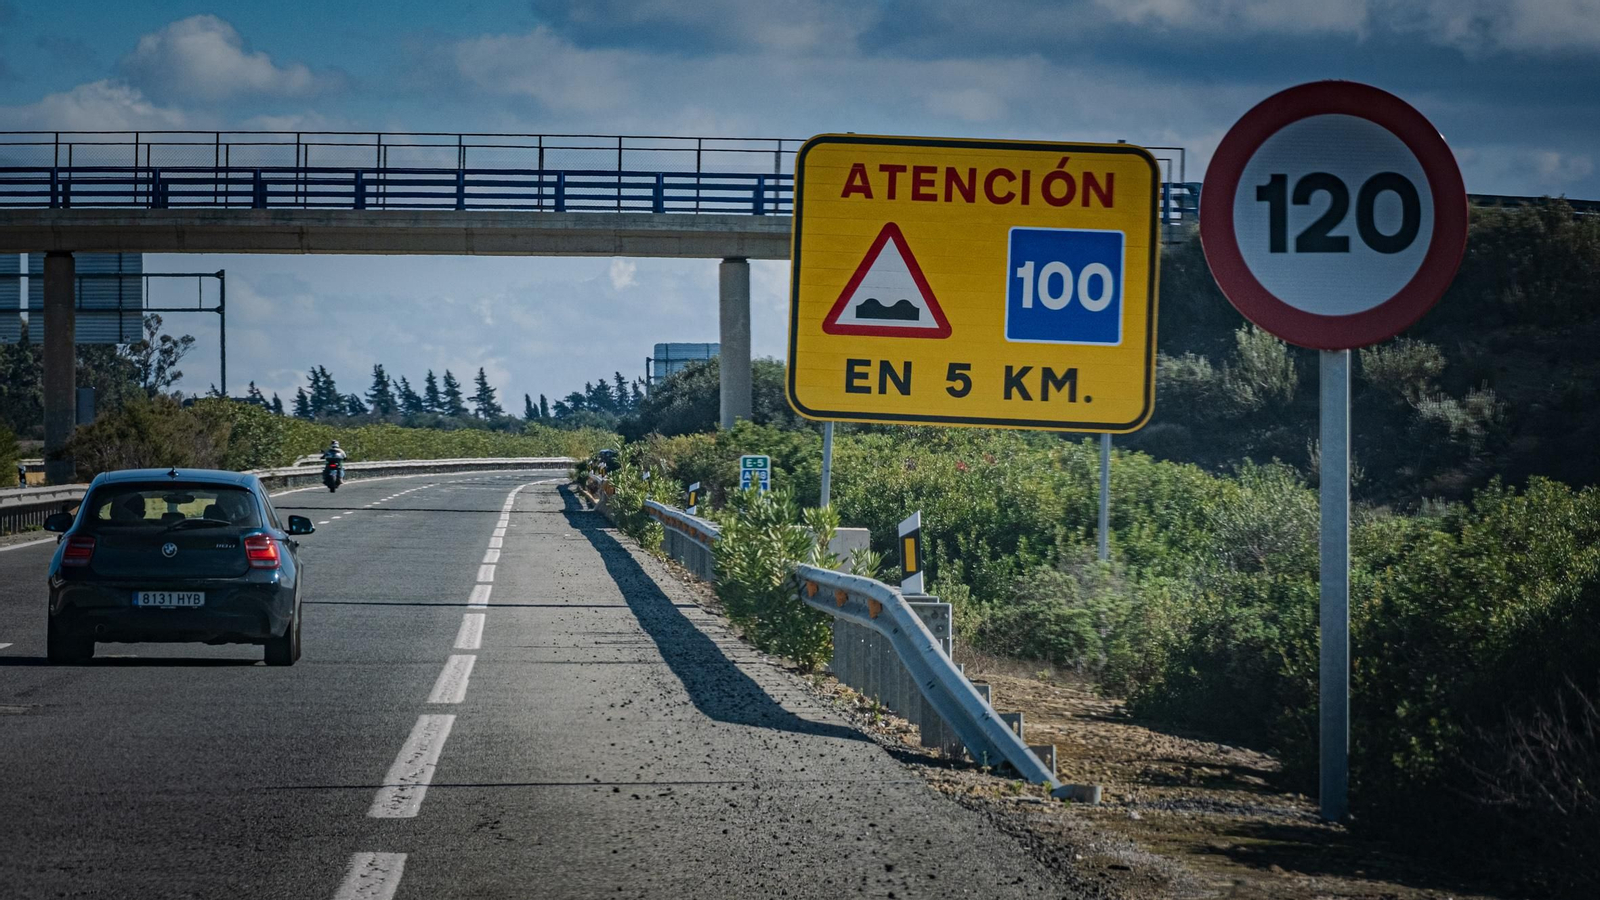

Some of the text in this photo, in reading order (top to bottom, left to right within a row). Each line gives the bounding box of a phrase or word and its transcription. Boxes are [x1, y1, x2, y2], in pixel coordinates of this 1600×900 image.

[840, 156, 1115, 208] ATENCIÓN
[1255, 171, 1422, 254] 120
[1016, 260, 1114, 312] 100
[845, 358, 1093, 404] EN 5 KM.
[746, 459, 765, 467] E-5
[142, 593, 201, 604] 8131 HYB
